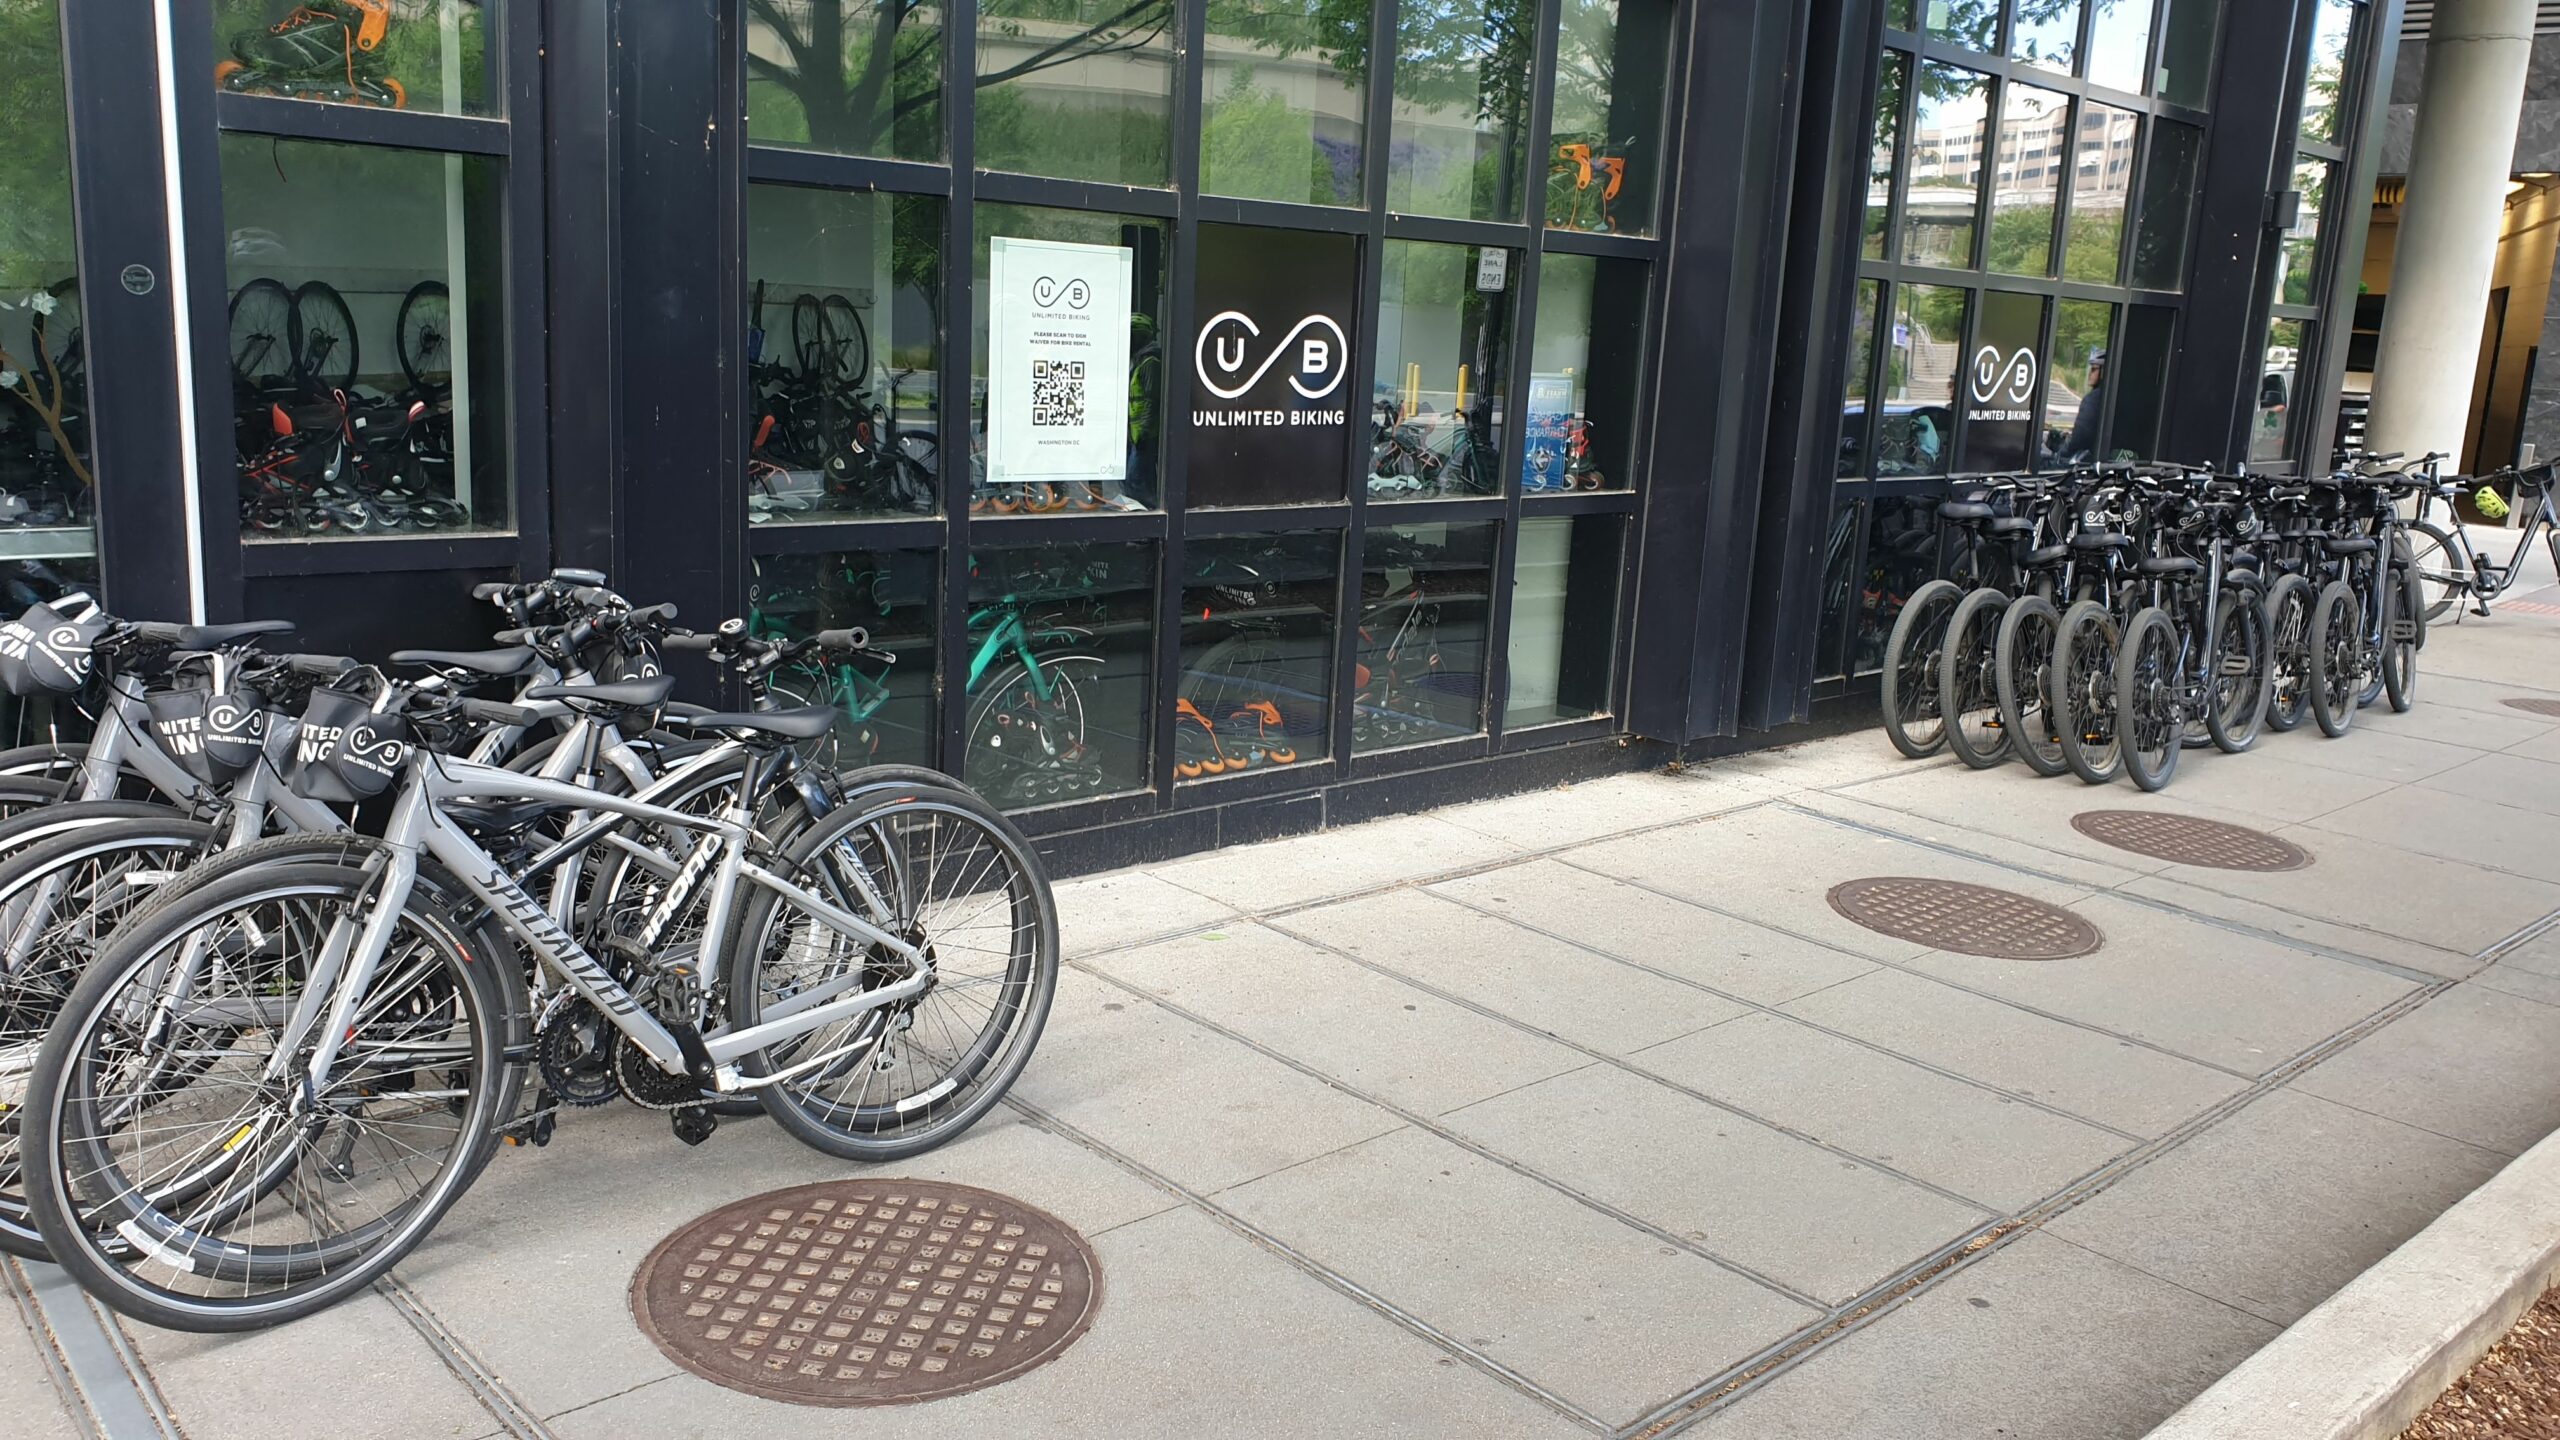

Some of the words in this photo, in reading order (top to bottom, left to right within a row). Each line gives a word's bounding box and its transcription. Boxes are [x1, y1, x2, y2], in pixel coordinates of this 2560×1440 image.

[1040, 285, 1051, 298] U
[1073, 287, 1083, 300] B
[1031, 311, 1067, 320] UNLIMITED
[1216, 337, 1245, 373] U
[1302, 339, 1329, 374] B
[1980, 362, 1994, 386] U
[2014, 363, 2029, 387] B
[1192, 410, 1285, 427] UNLIMITED
[1290, 410, 1345, 426] BIKING
[2007, 410, 2031, 421] BIKING
[207, 733, 247, 744] UNLIMITED
[343, 753, 377, 771] UNLIMITED
[472, 868, 640, 1016] SPECIALIZED
